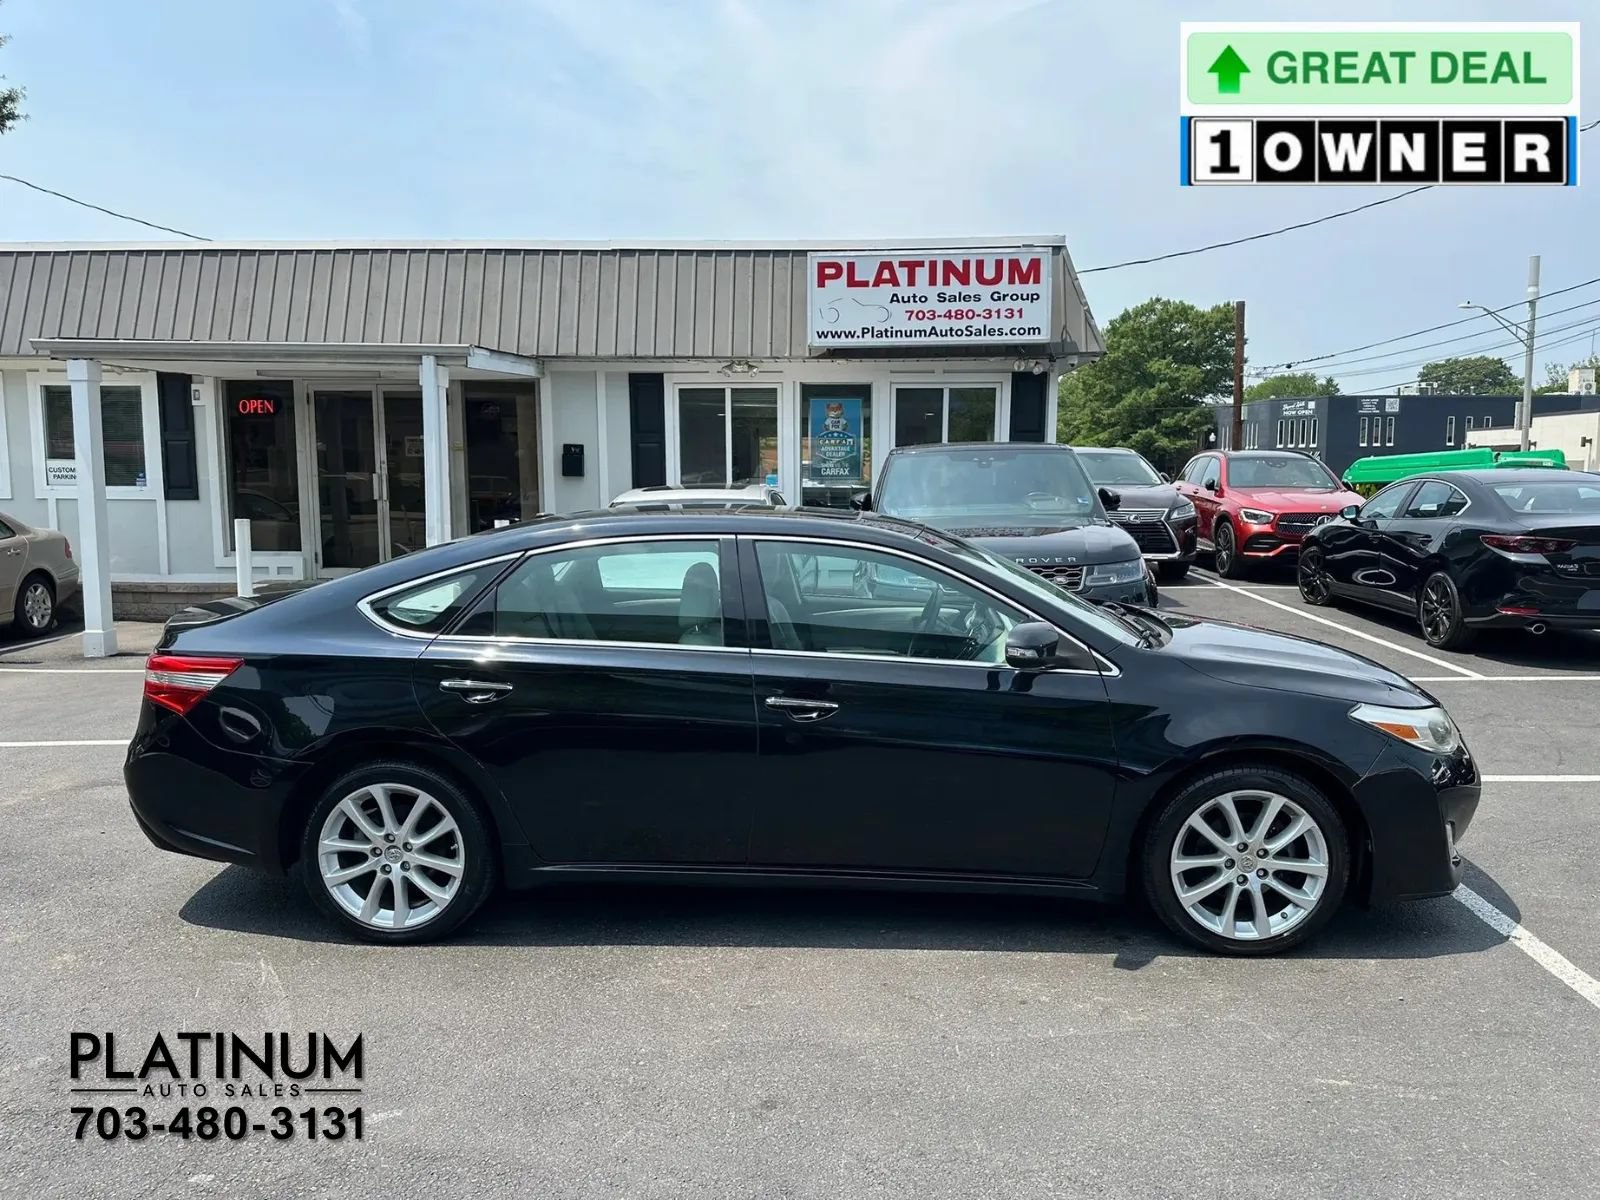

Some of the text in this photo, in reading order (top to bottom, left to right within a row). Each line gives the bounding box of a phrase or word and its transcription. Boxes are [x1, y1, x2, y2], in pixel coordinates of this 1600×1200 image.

[816, 257, 1041, 288] PLATINUM
[889, 291, 1040, 304] Auto Sales Group
[904, 308, 1024, 321] 703-480-3131
[816, 324, 1041, 340] www.PlatinumAutoSales.com
[239, 400, 274, 413] OPEN
